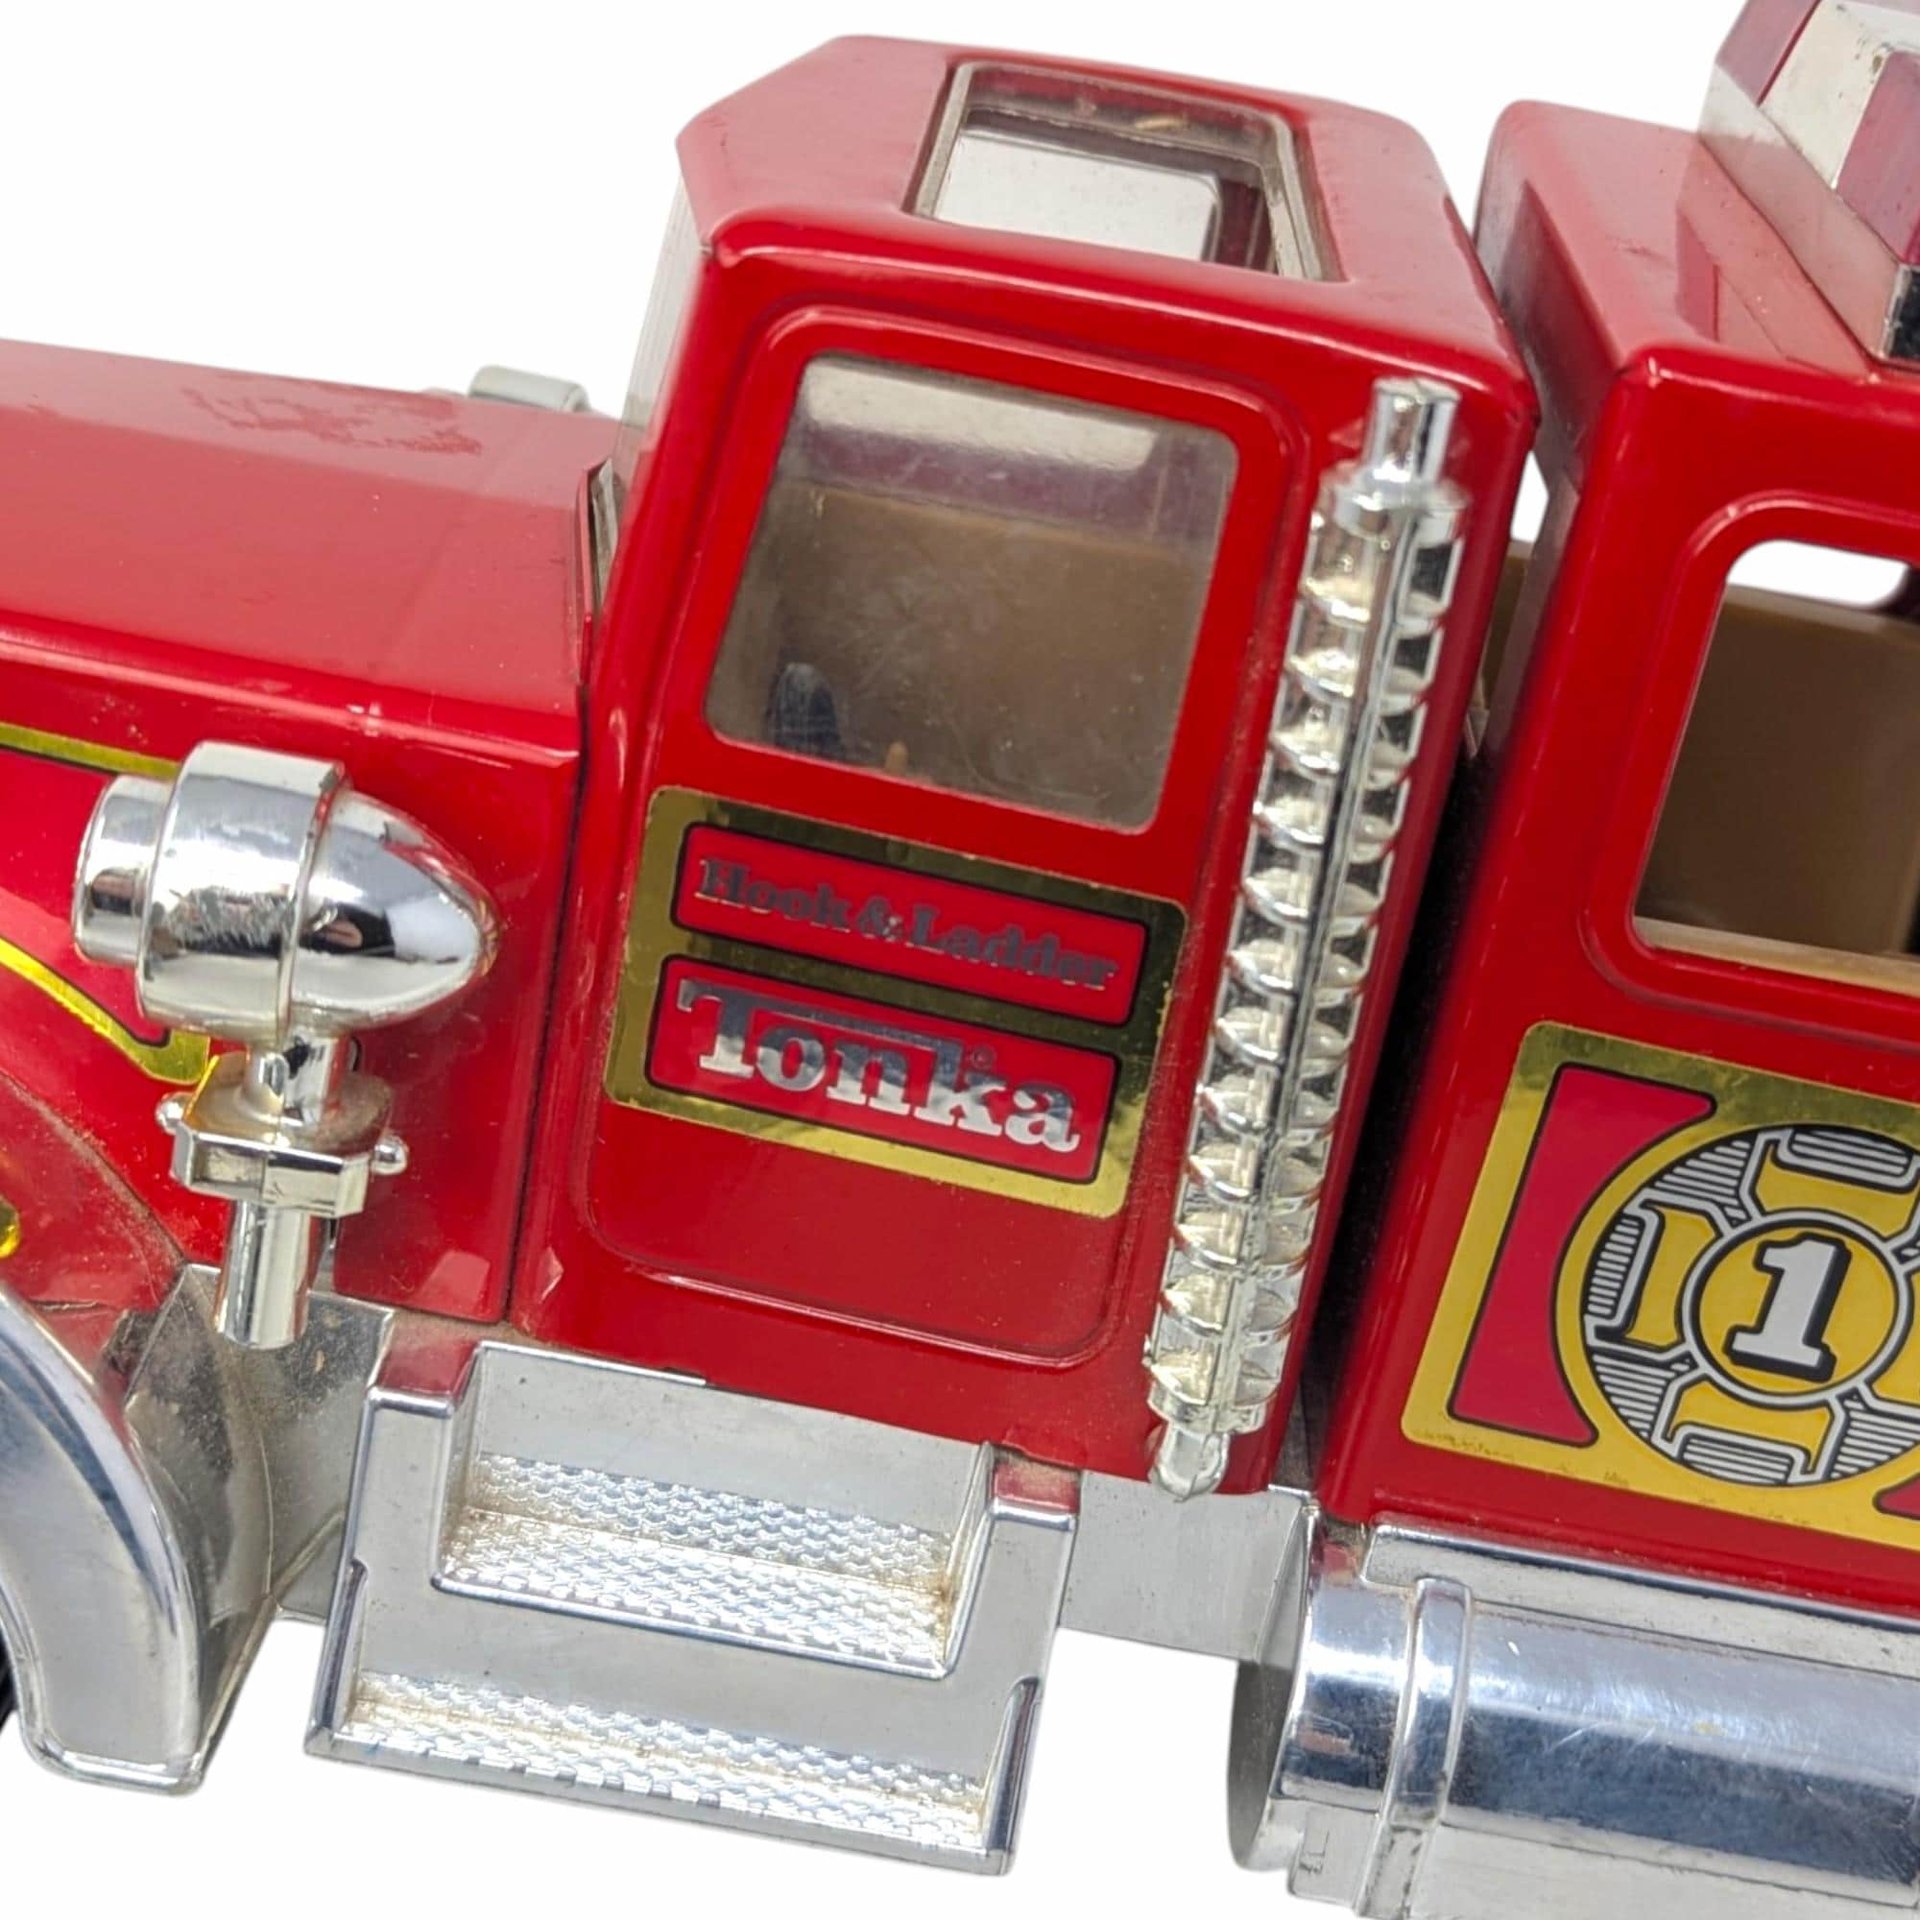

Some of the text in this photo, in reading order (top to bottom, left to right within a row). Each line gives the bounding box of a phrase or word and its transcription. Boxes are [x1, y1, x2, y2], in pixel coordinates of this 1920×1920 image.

[695, 859, 850, 932] Hook
[905, 907, 1118, 990] Ladder
[676, 979, 1079, 1153] Tonka
[1723, 1233, 1851, 1381] 1
